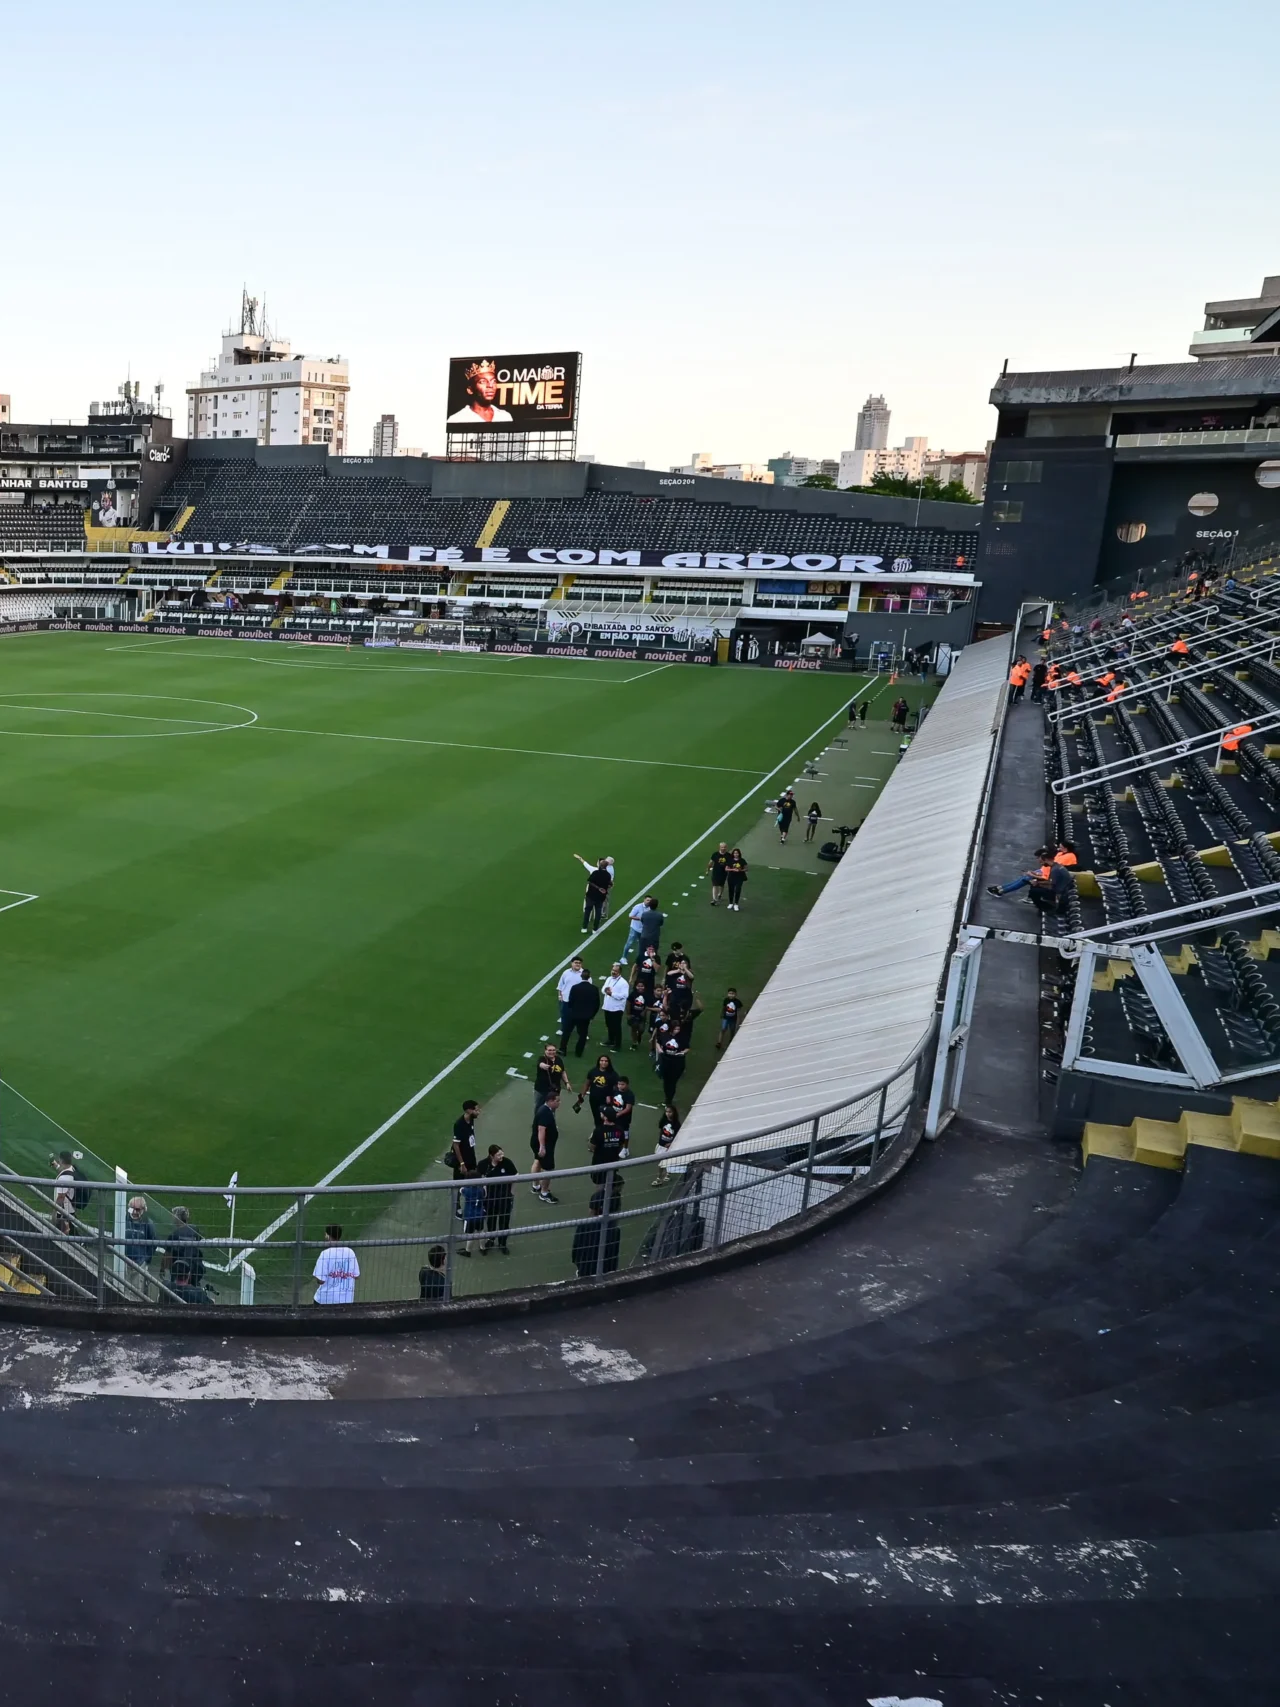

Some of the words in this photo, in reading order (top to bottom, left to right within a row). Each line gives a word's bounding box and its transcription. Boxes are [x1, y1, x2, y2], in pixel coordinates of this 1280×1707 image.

[497, 369, 510, 382] O
[496, 381, 564, 405] TIME
[149, 447, 168, 462] Claro
[39, 480, 88, 489] SANTOS
[1196, 529, 1232, 539] SEÇÃO
[409, 546, 465, 562] FÉ
[482, 548, 511, 562] E
[527, 548, 640, 565] COM
[662, 551, 885, 573] ARDOR
[19, 622, 38, 632] novibet
[584, 622, 626, 631] EMBAIXADA
[85, 622, 113, 632] novibet
[119, 624, 148, 633] novibet
[154, 625, 186, 635] novibet
[198, 628, 233, 638] novibet
[238, 630, 273, 639] novibet
[279, 632, 313, 641] novibet
[318, 633, 352, 643] novibet
[494, 643, 533, 653] novibet
[546, 646, 588, 656] novibet
[595, 647, 637, 659] novibet
[645, 650, 687, 661] novibet
[774, 658, 822, 669] novibet
